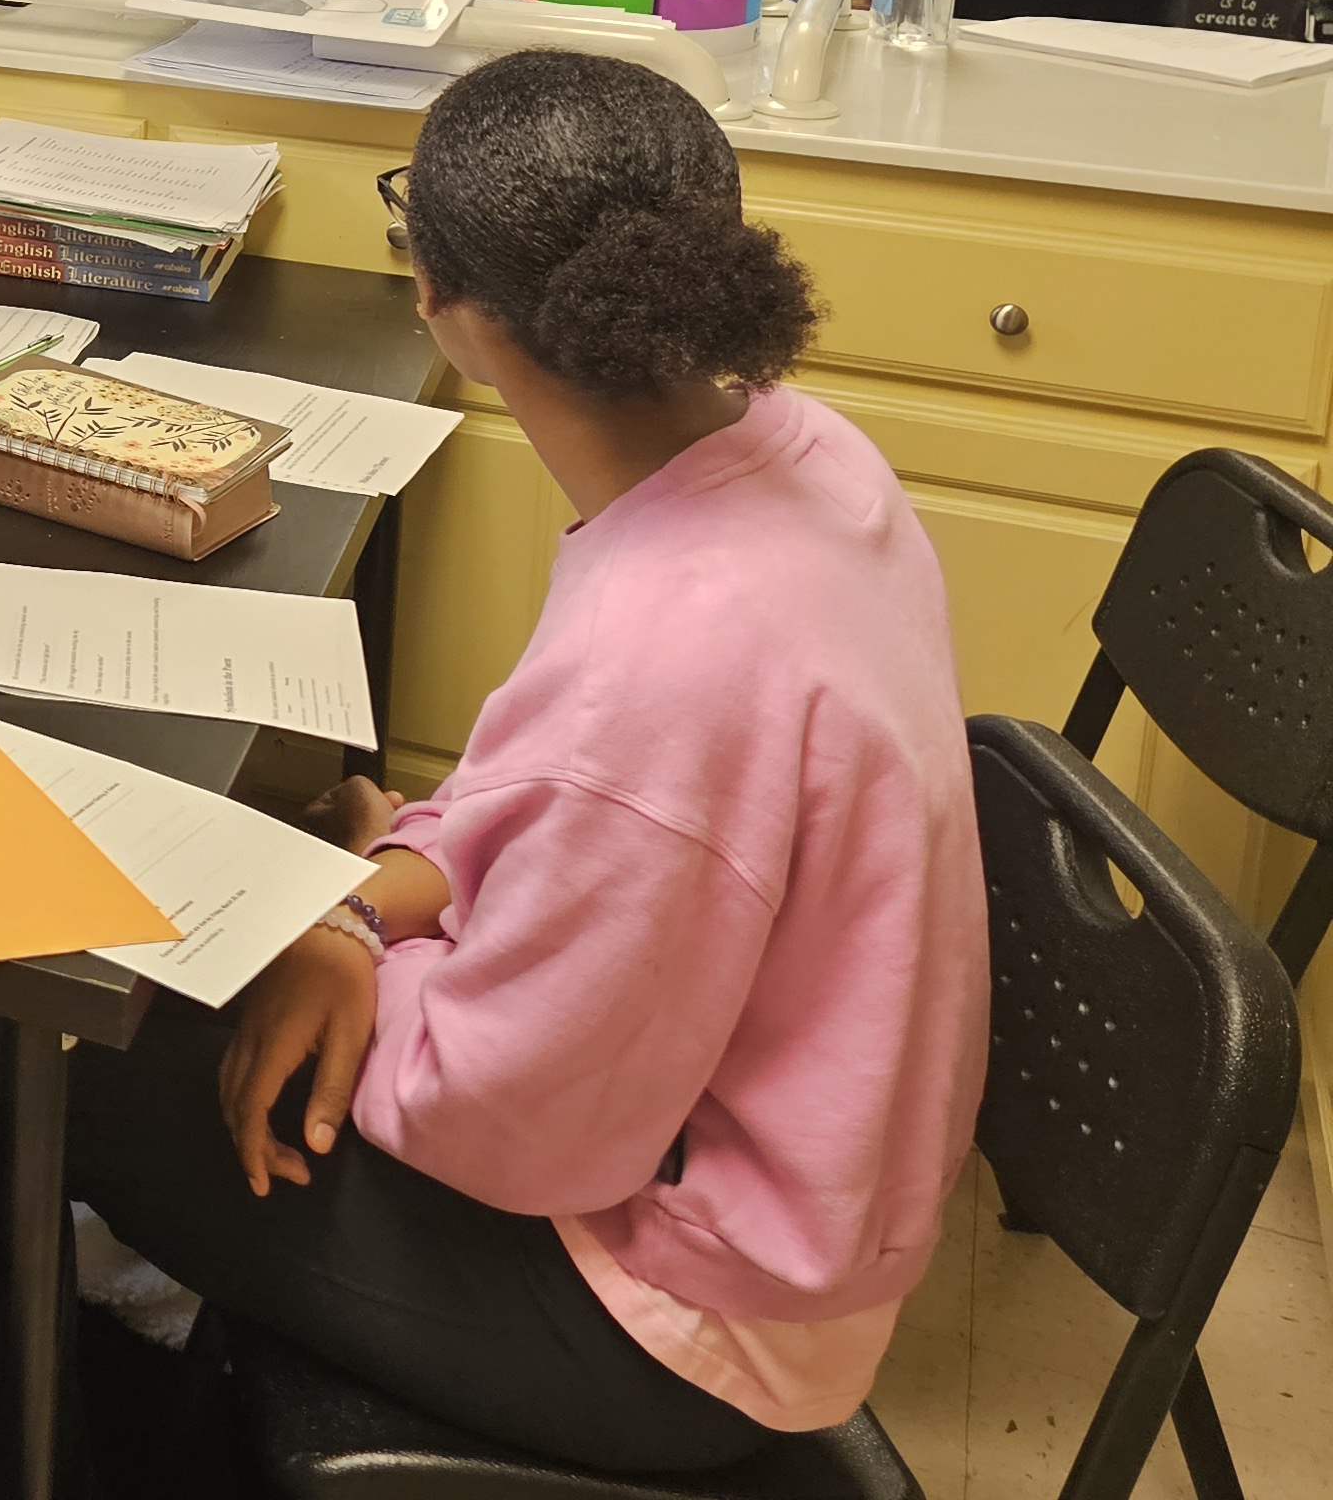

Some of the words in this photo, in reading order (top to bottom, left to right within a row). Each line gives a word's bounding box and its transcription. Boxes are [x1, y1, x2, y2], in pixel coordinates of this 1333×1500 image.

[1195, 13, 1258, 27] create
[1261, 13, 1279, 29] it
[51, 224, 136, 248] Literature
[58, 244, 145, 269] Literature
[66, 266, 154, 291] Literature
[221, 657, 232, 671] Poem
[222, 671, 232, 679] the
[222, 685, 237, 714] Symbolism
